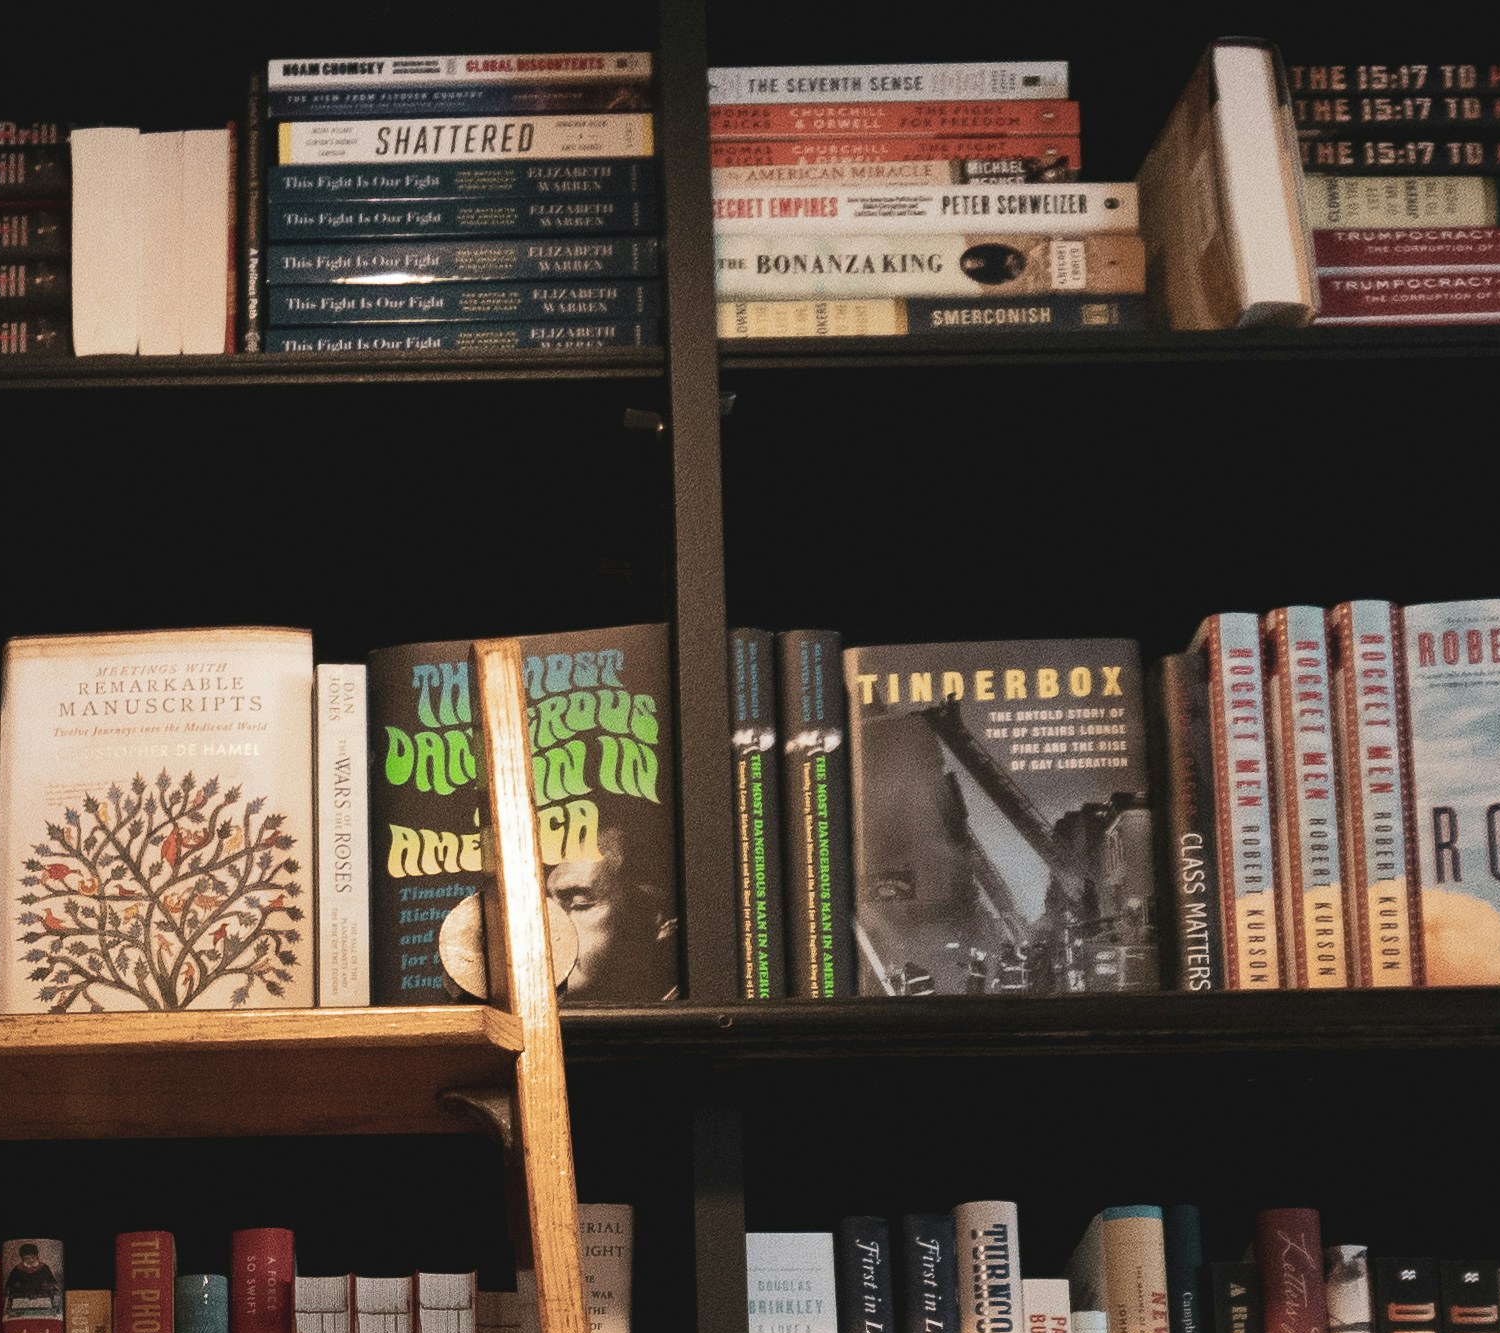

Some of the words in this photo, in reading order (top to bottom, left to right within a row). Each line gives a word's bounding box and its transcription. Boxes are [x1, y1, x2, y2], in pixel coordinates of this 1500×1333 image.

[320, 60, 384, 76] CHOMSKY
[374, 121, 535, 157] SHATTERED
[281, 175, 314, 191] This
[318, 174, 352, 192] Fight
[356, 175, 367, 190] Is
[403, 171, 440, 190] Fight
[756, 252, 875, 273] BONANZA
[881, 252, 943, 273] KING
[932, 306, 1051, 326] SMERCONISH
[856, 666, 1123, 705] TINDERBOX
[1180, 833, 1204, 899] CLASS
[1184, 908, 1211, 992] MATTERS
